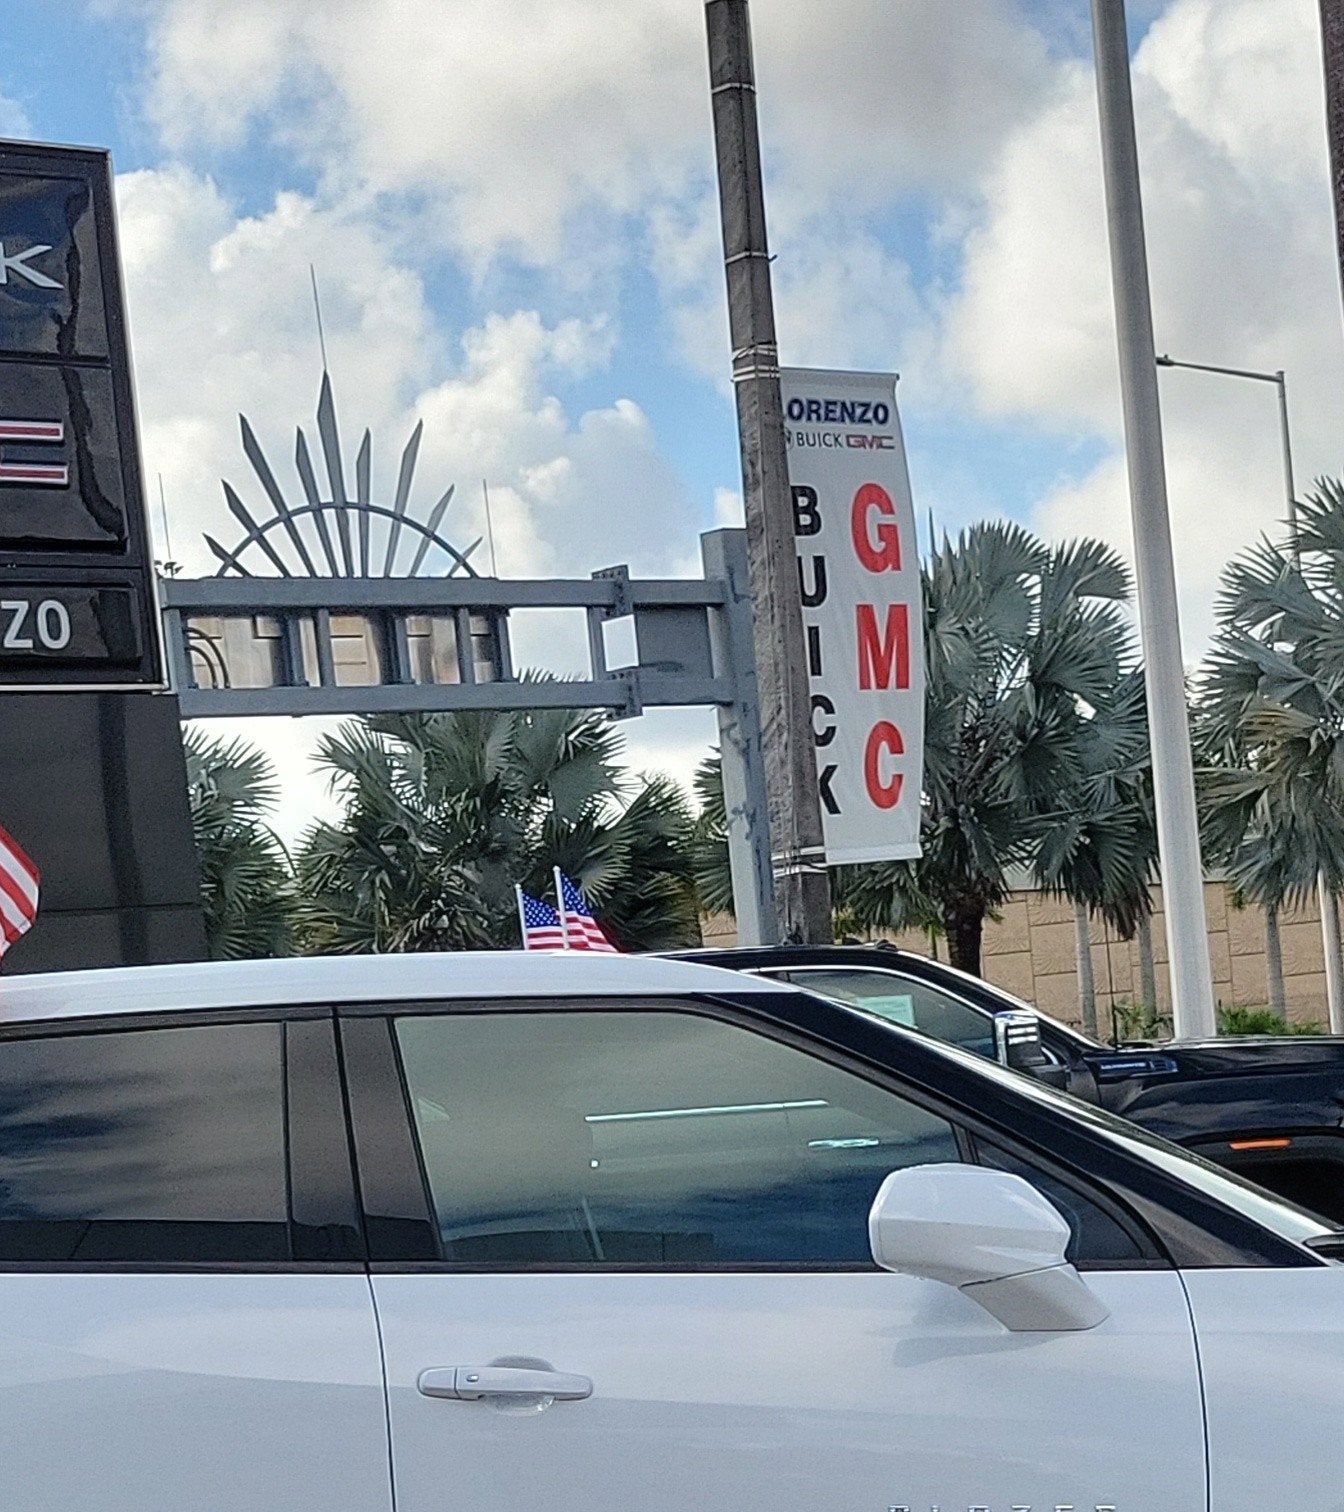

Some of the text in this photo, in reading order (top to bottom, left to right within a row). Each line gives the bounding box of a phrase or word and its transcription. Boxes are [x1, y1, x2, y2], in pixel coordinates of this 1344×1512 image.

[787, 398, 890, 425] ORENZO
[796, 431, 895, 449] BUICK GMC
[791, 485, 842, 816] BUICK
[851, 482, 909, 811] GMC
